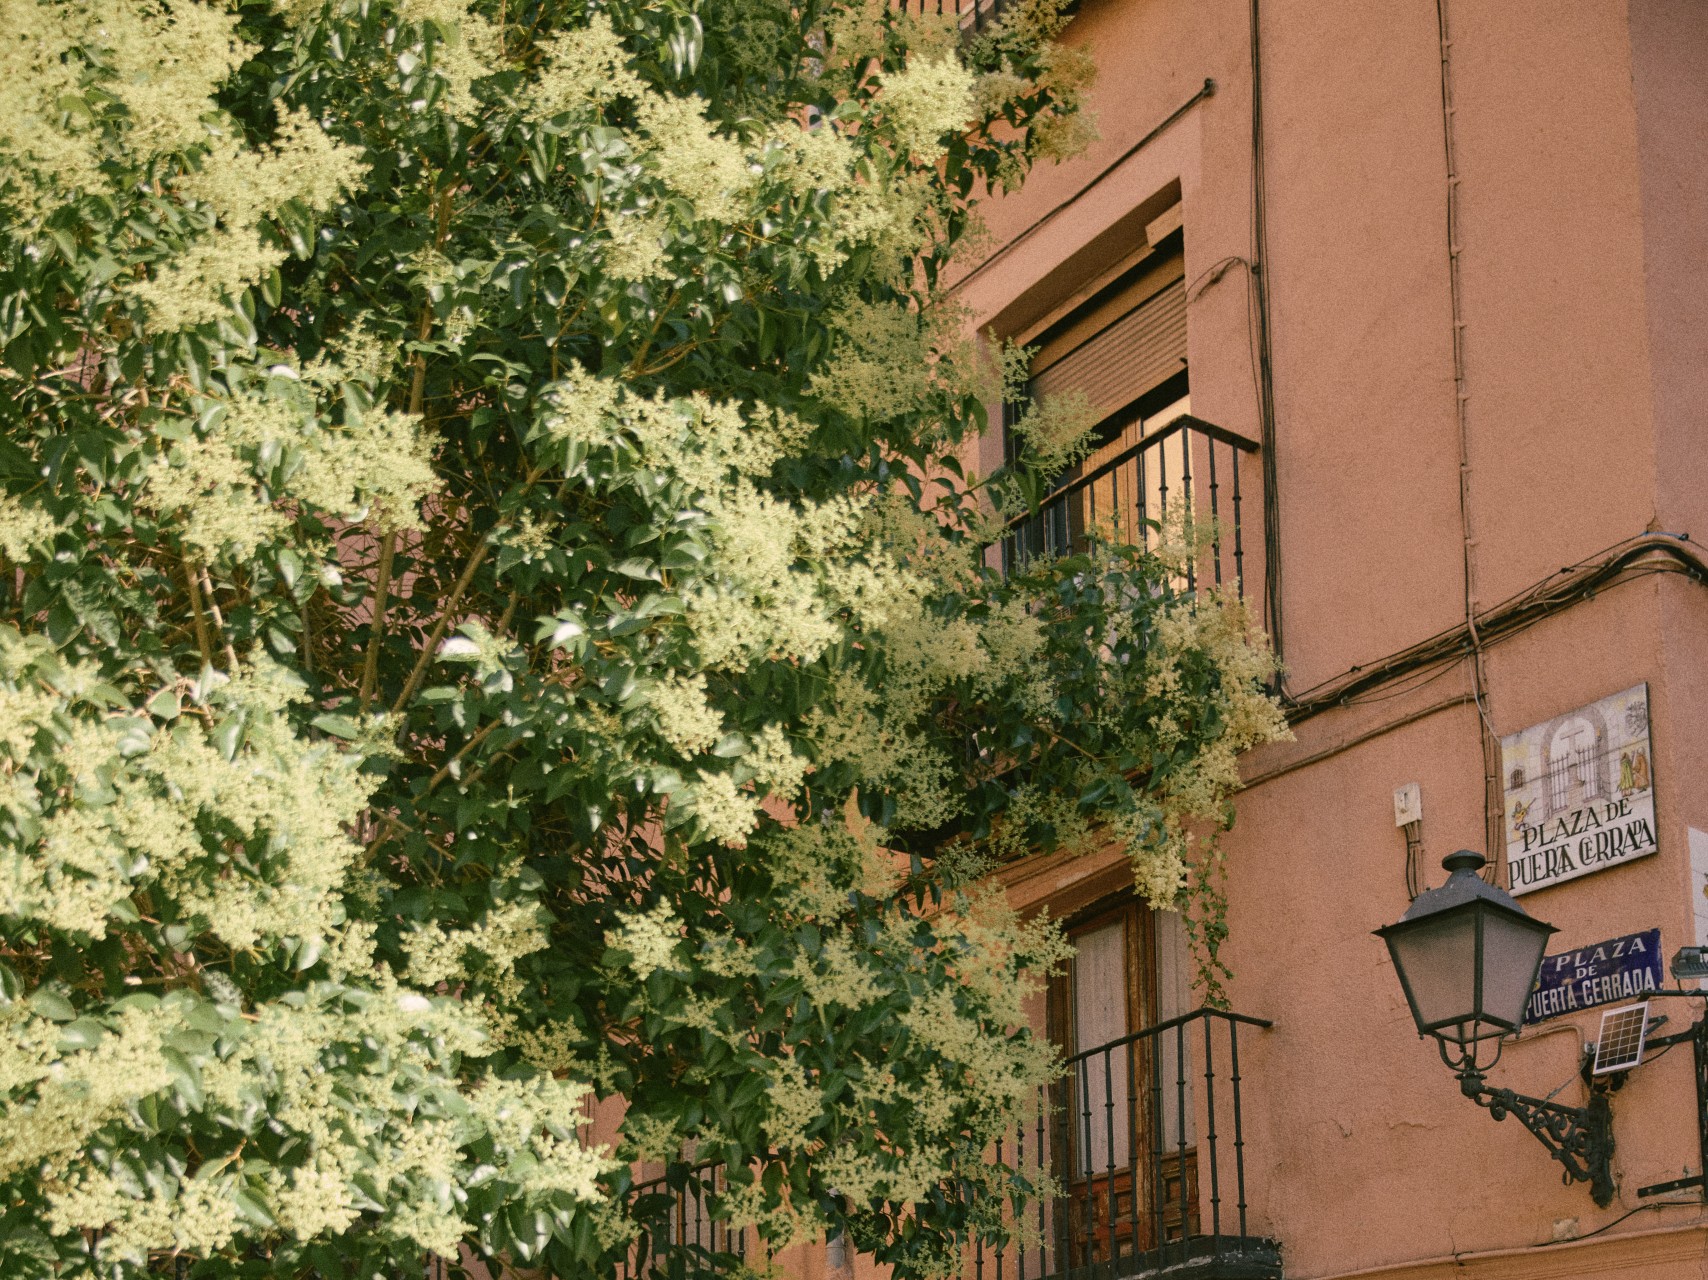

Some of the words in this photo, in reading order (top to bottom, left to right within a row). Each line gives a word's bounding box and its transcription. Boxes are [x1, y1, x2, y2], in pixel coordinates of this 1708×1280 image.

[1522, 806, 1602, 853] PLAZA
[1605, 797, 1633, 822] DE
[1508, 843, 1577, 890] PUERTA
[1579, 818, 1656, 866] CERRADA
[1555, 937, 1646, 972] PLAZA
[1576, 965, 1598, 979] DE
[1526, 984, 1578, 1020] PUERTA
[1582, 966, 1655, 1006] CERRADA
